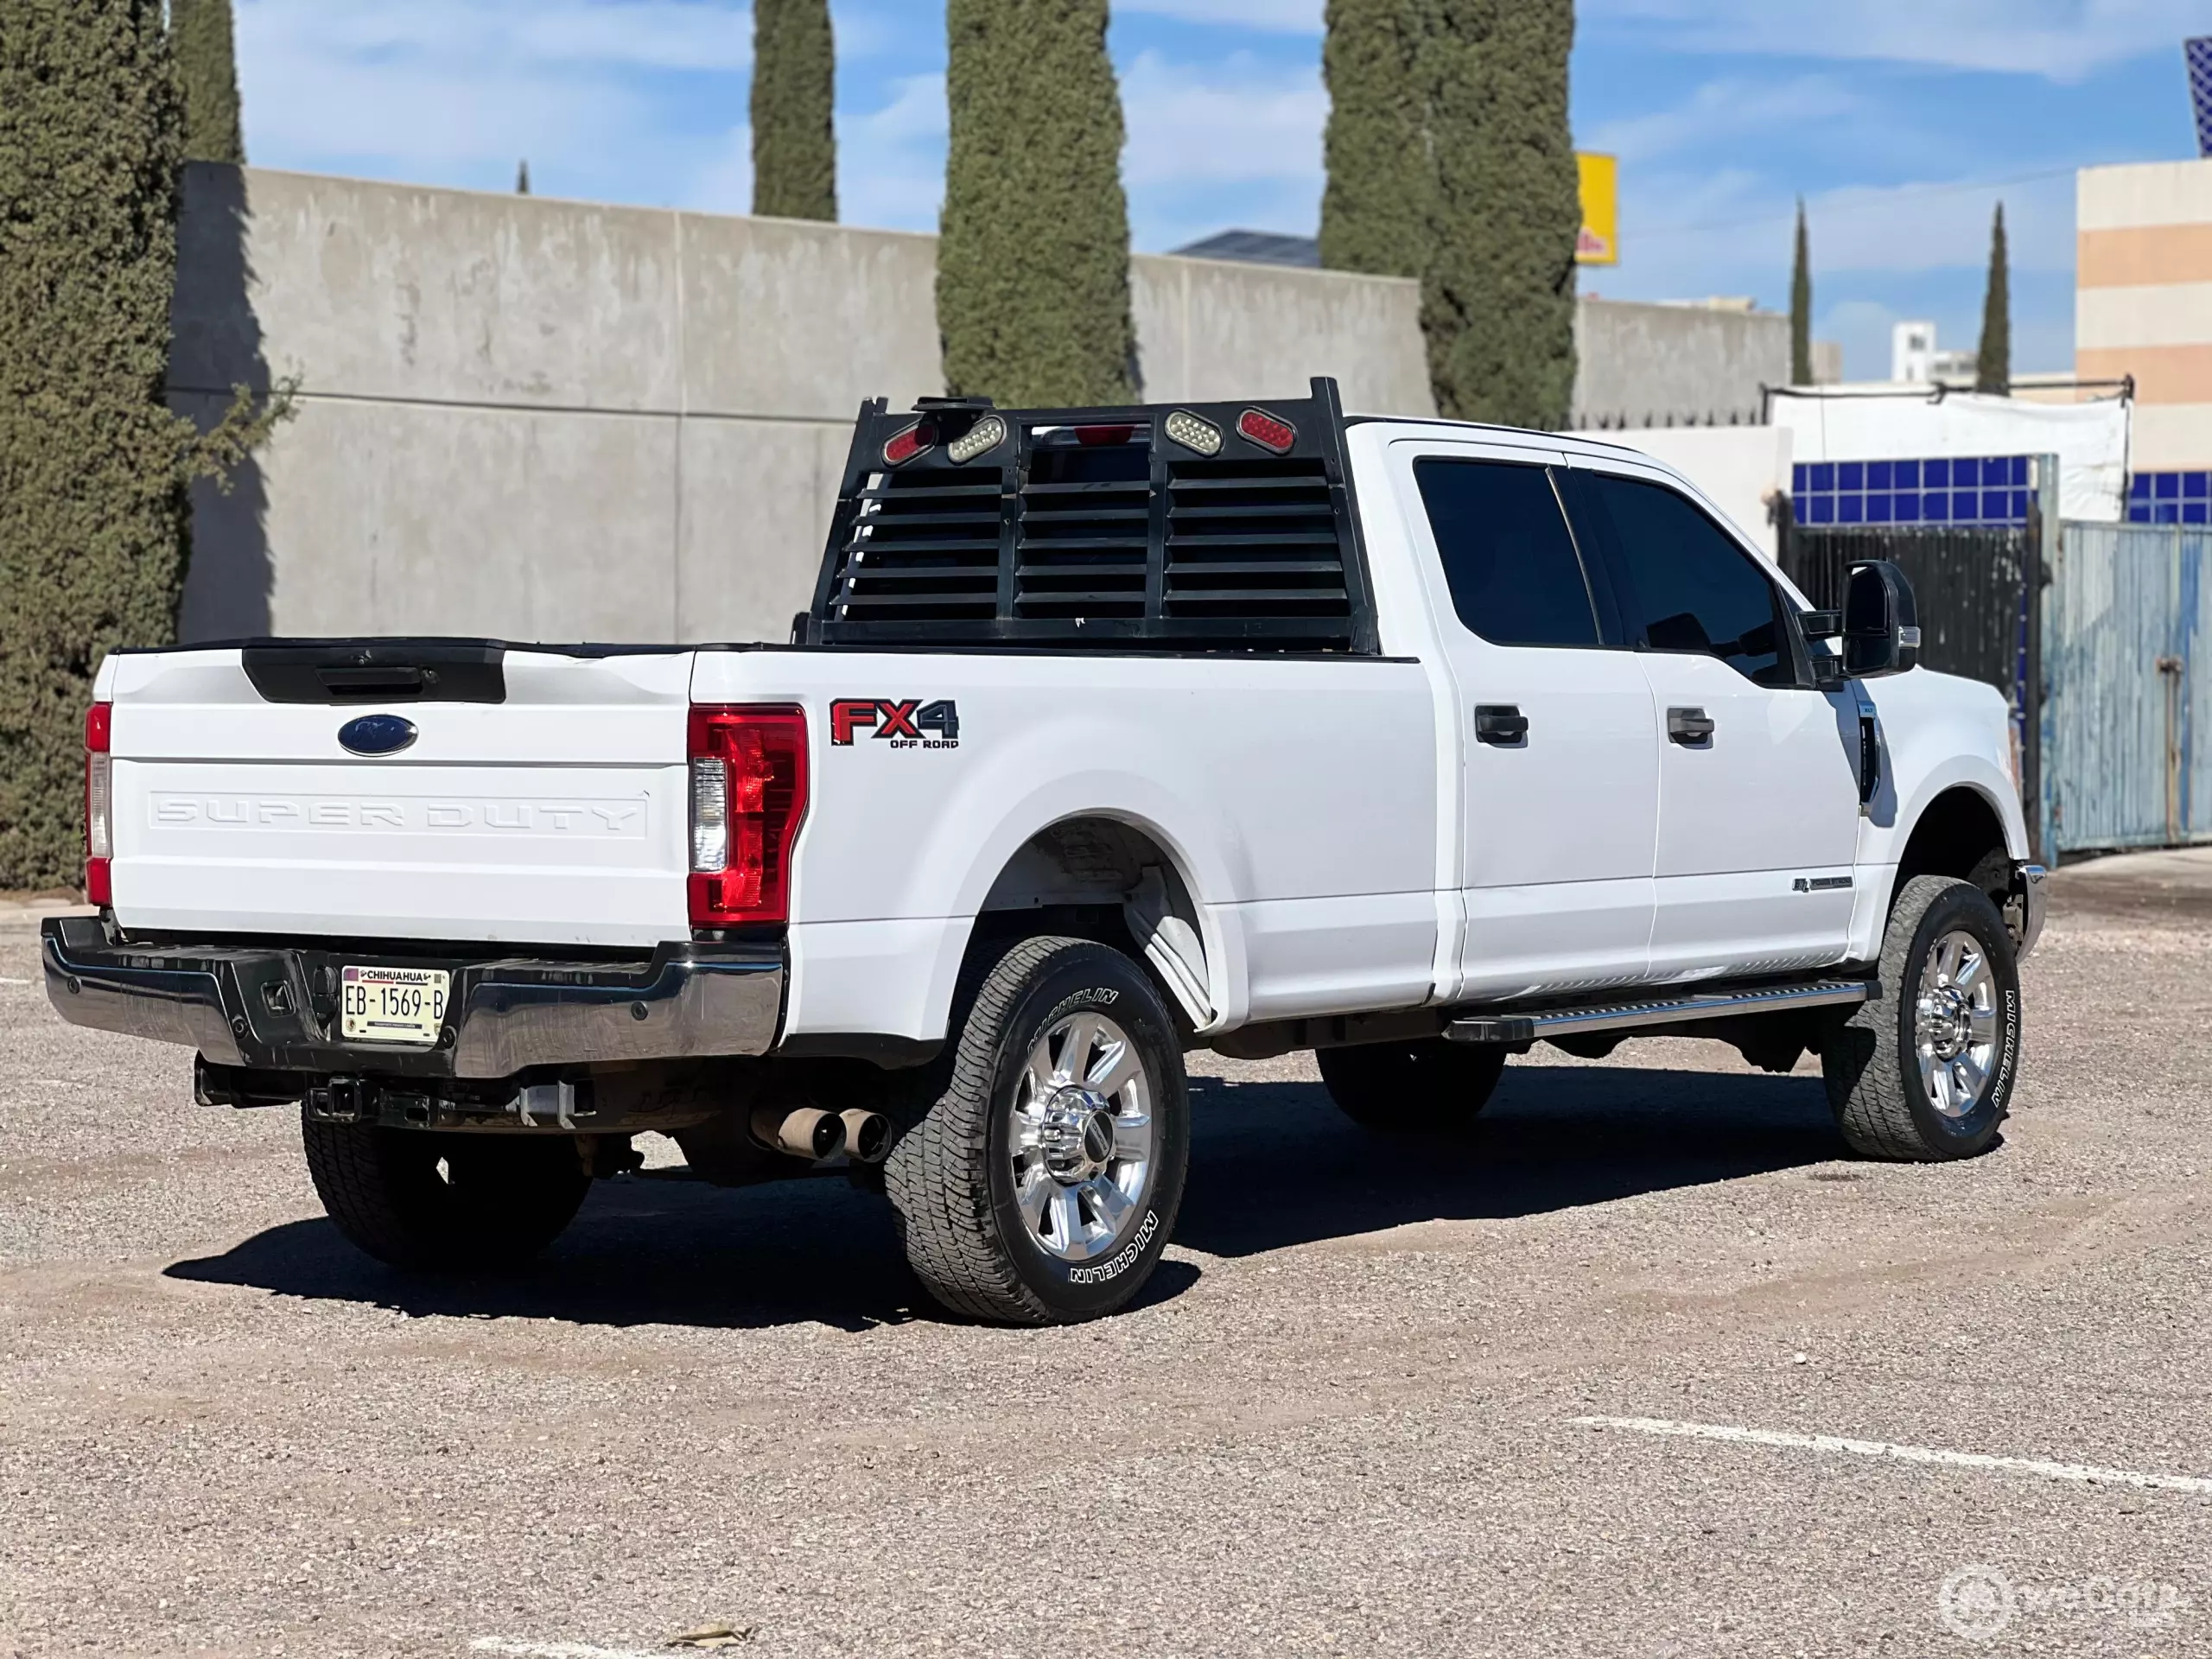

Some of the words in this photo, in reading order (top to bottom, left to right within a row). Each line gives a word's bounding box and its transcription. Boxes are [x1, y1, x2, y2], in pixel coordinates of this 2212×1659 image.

[830, 698, 959, 746] FX4
[890, 740, 918, 749] OFF
[923, 740, 959, 749] ROAD
[156, 798, 405, 828] SUPER
[426, 802, 639, 832] DUTY
[367, 969, 423, 982] CHIHUAHUA
[346, 985, 443, 1020] EB-1569-B
[1027, 988, 1120, 1058] MICHELIN
[1991, 989, 2017, 1109] MICHELIN
[1070, 1209, 1160, 1284] MICHELIN
